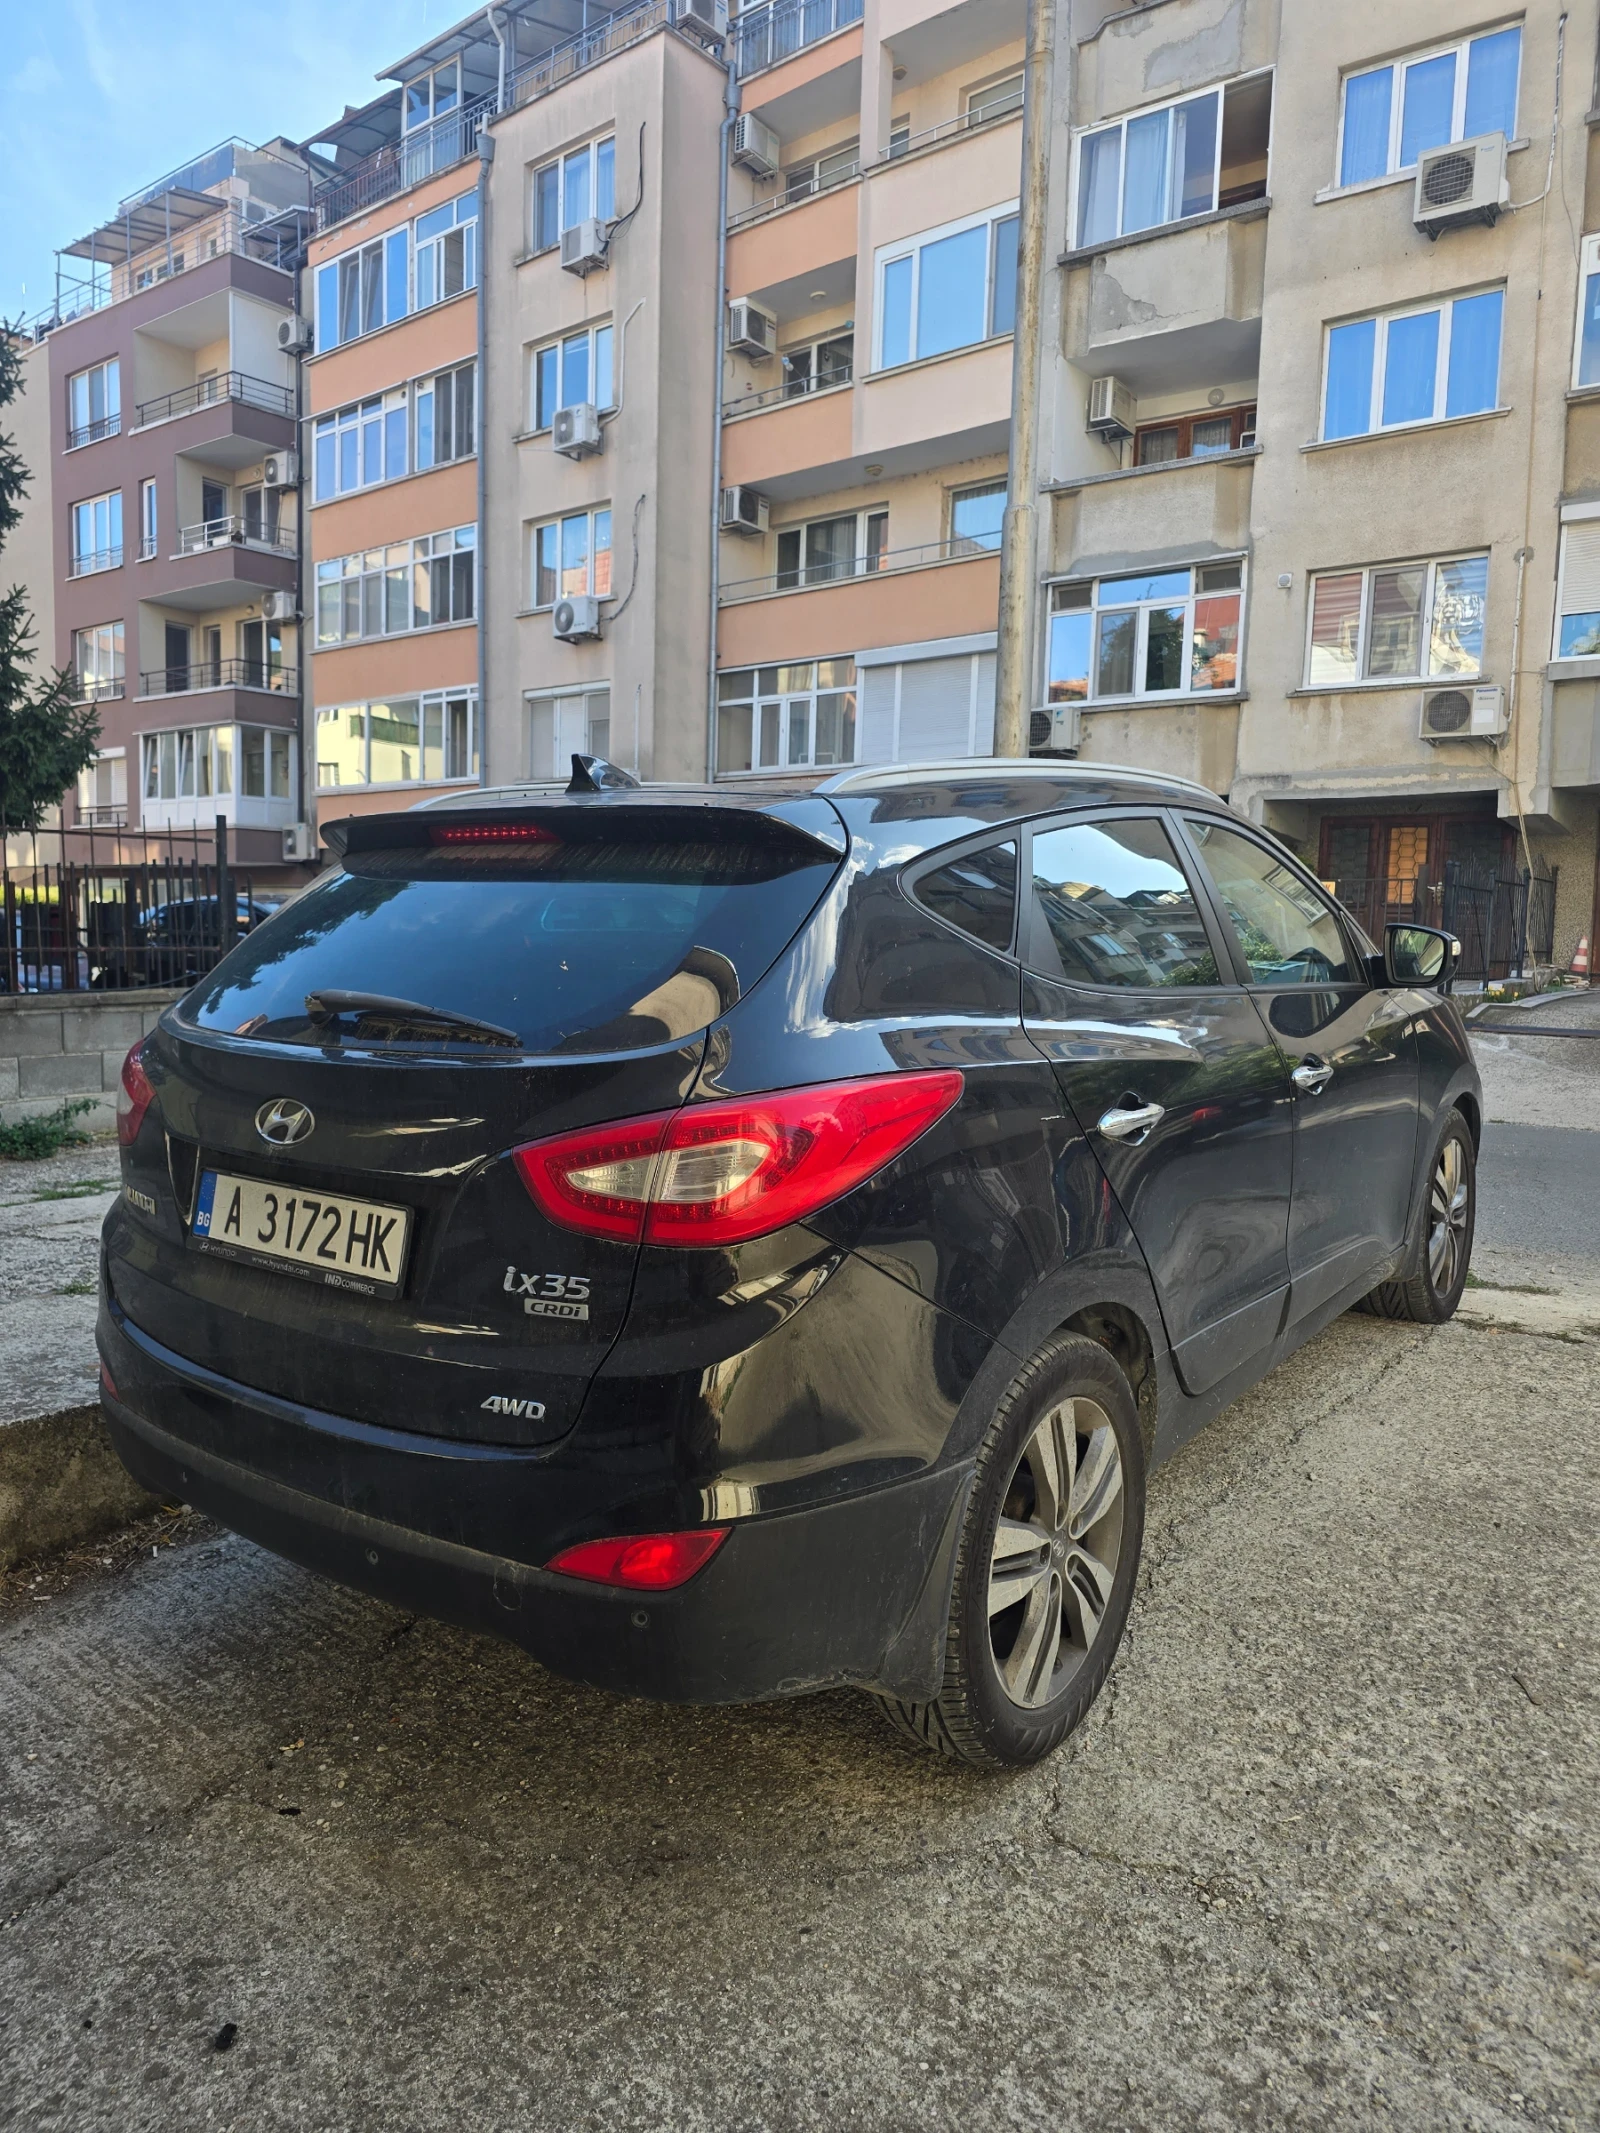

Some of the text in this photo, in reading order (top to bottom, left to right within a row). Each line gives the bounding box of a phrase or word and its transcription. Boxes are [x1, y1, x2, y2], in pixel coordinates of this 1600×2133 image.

[196, 1210, 210, 1227] BG
[223, 1186, 242, 1237] A
[251, 1255, 310, 1277] www.hyundai.com
[503, 1265, 591, 1300] ix35
[530, 1302, 581, 1317] CRDi
[480, 1395, 546, 1420] 4WD
